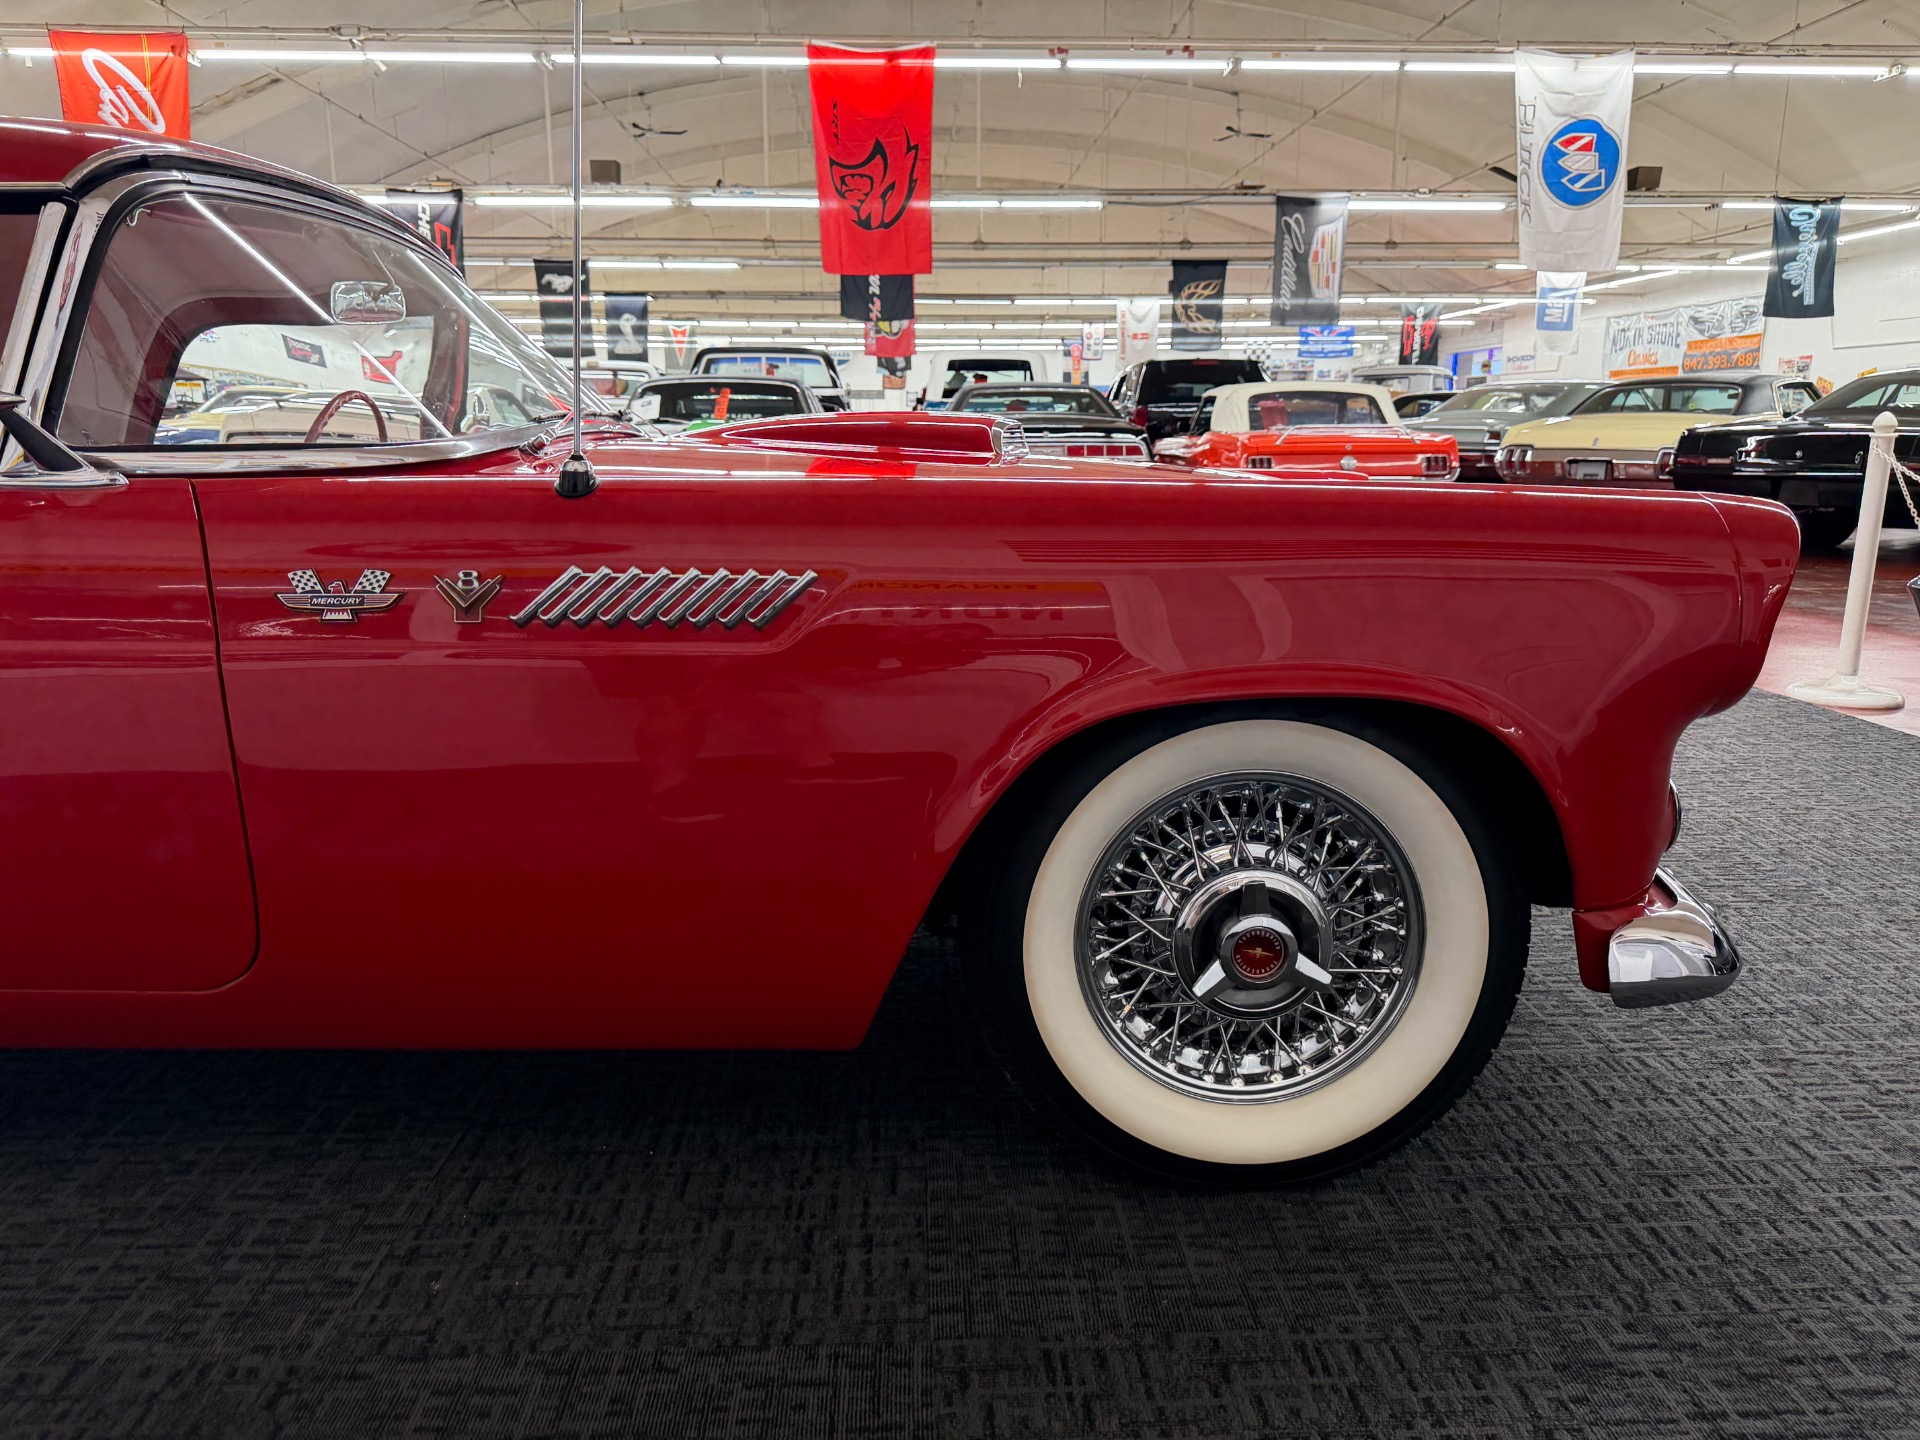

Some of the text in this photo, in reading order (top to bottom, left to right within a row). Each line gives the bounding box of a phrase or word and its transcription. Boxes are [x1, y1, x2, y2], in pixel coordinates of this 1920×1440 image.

[1519, 96, 1537, 224] BUICK
[1280, 212, 1306, 311] Cadillac
[1610, 326, 1644, 355] NORTH
[1647, 321, 1682, 349] SHORE
[1683, 352, 1760, 372] 847.393.7887
[311, 596, 363, 606] MERCURY
[1238, 929, 1281, 950] THUNDERBIRD
[1235, 954, 1278, 974] THUNDERBIRD
